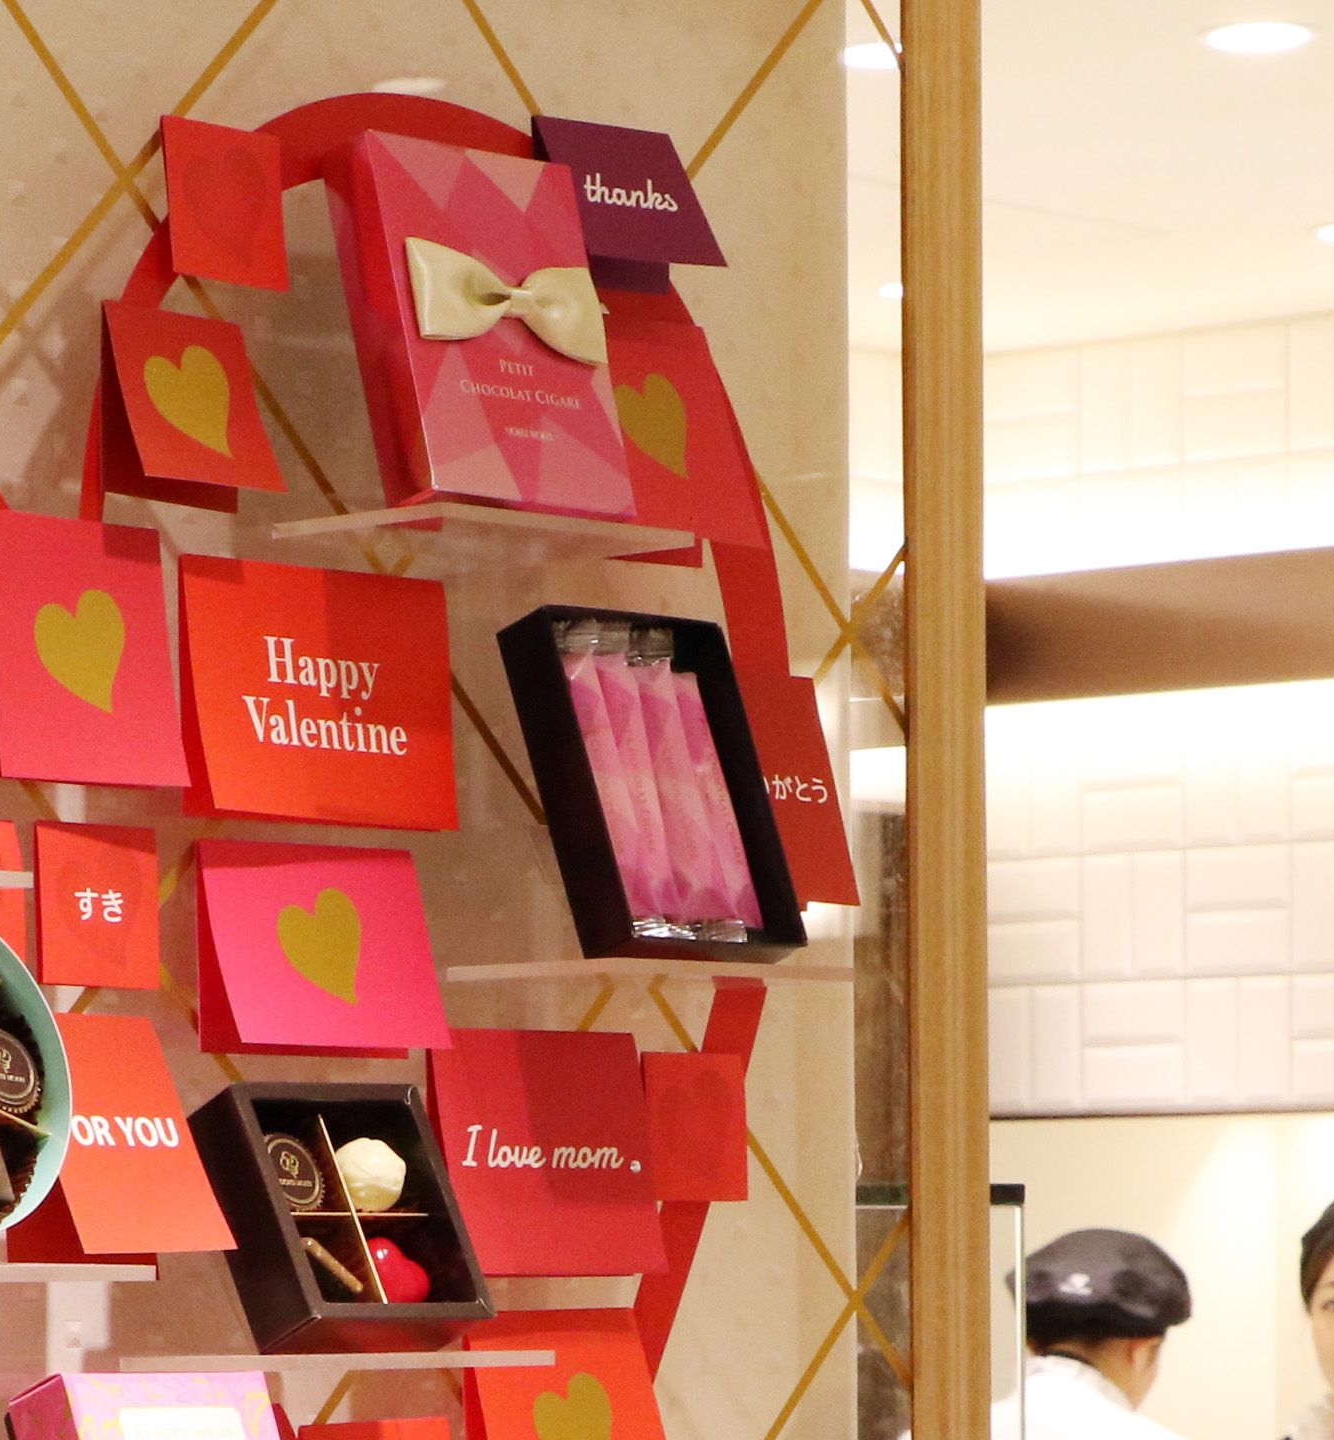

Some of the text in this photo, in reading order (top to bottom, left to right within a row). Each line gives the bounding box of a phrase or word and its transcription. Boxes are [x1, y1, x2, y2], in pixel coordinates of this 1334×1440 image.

[583, 172, 679, 213] thanks
[498, 358, 535, 377] PETIT
[459, 379, 582, 409] CHOCOLAT CIGARE
[263, 635, 380, 701] Happy
[241, 694, 408, 756] Valentine
[763, 773, 829, 804] がとう
[73, 886, 124, 924] すき
[71, 1114, 181, 1148] OR YOU
[461, 1123, 484, 1168] I
[487, 1128, 547, 1169] love
